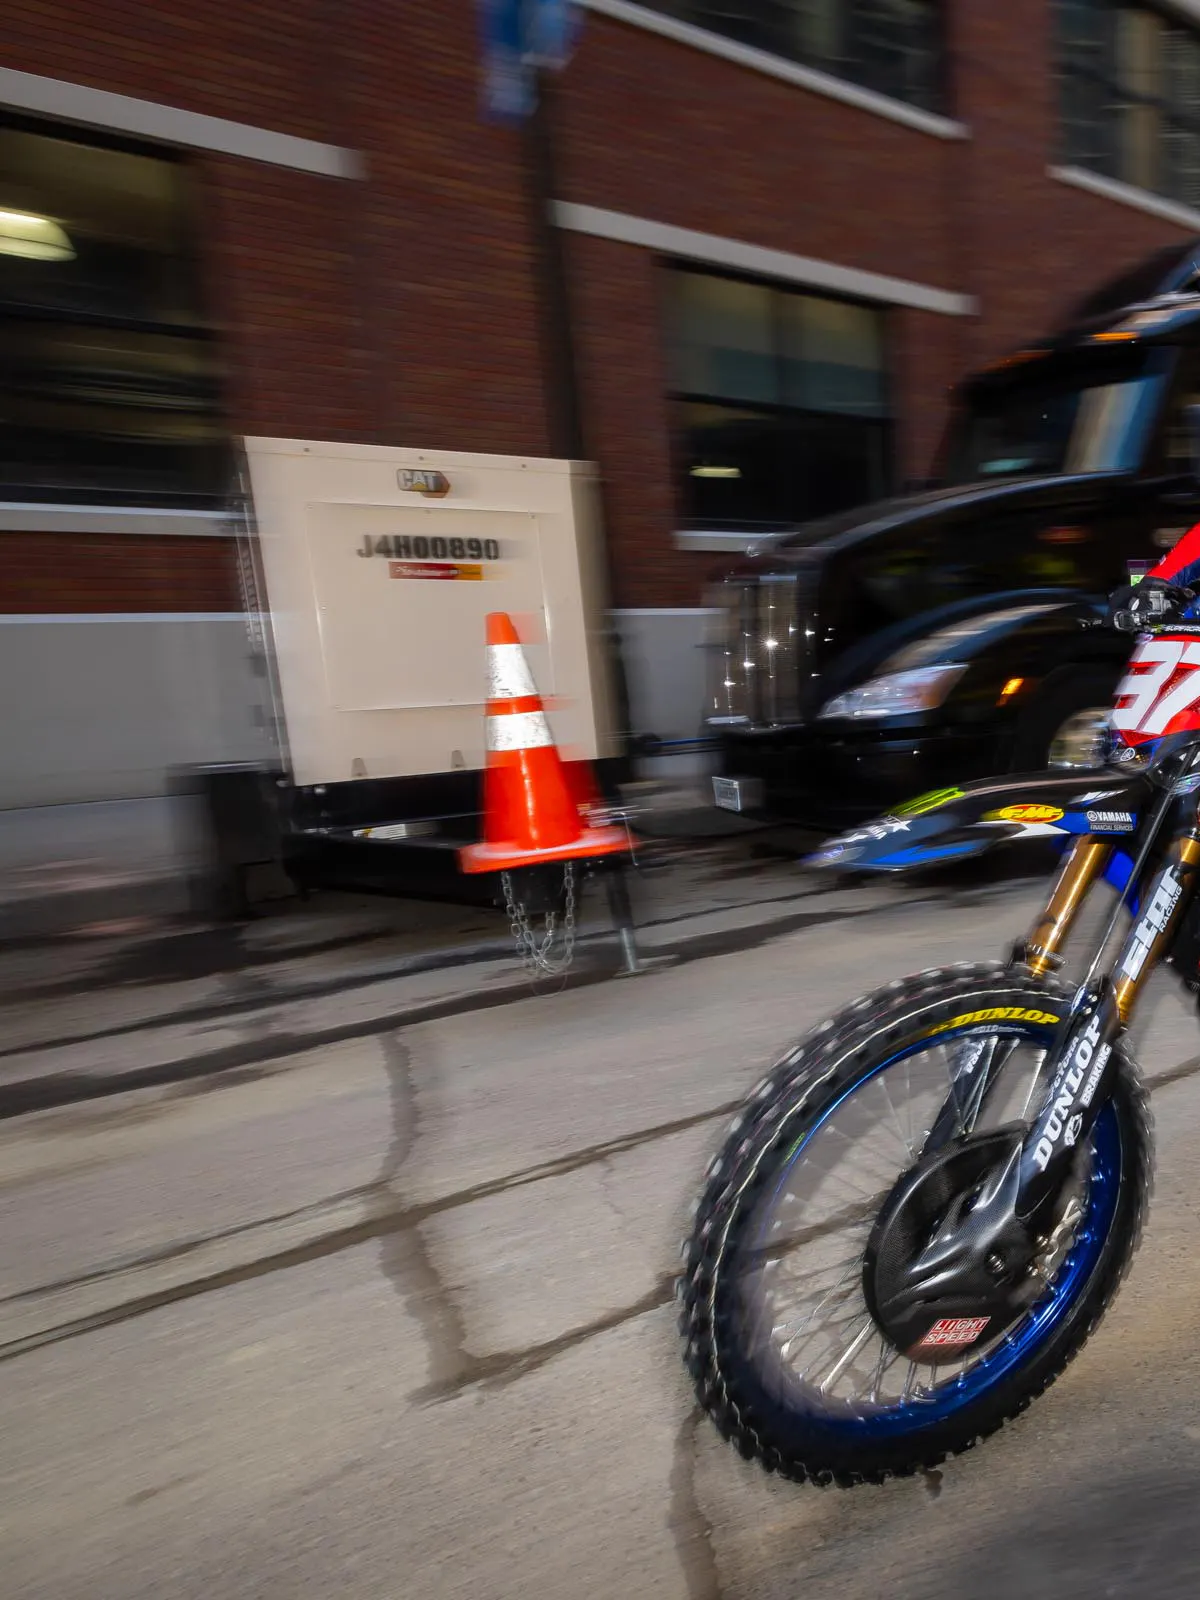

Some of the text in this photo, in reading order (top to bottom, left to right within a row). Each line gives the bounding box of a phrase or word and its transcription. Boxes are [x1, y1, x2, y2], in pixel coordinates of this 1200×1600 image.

[401, 469, 438, 492] CAT
[357, 535, 500, 560] J4H00890
[1006, 807, 1063, 819] FMF
[1098, 811, 1132, 822] YAMAHA
[1090, 823, 1114, 831] FINANCIAL
[1159, 886, 1182, 933] RACING
[1122, 865, 1179, 983] star
[951, 1007, 1061, 1029] DUNLOP
[1080, 1042, 1112, 1107] BRAKING
[1032, 1014, 1101, 1172] DUNLOP
[935, 1321, 985, 1330] LIGHT
[926, 1332, 979, 1343] SPEED
